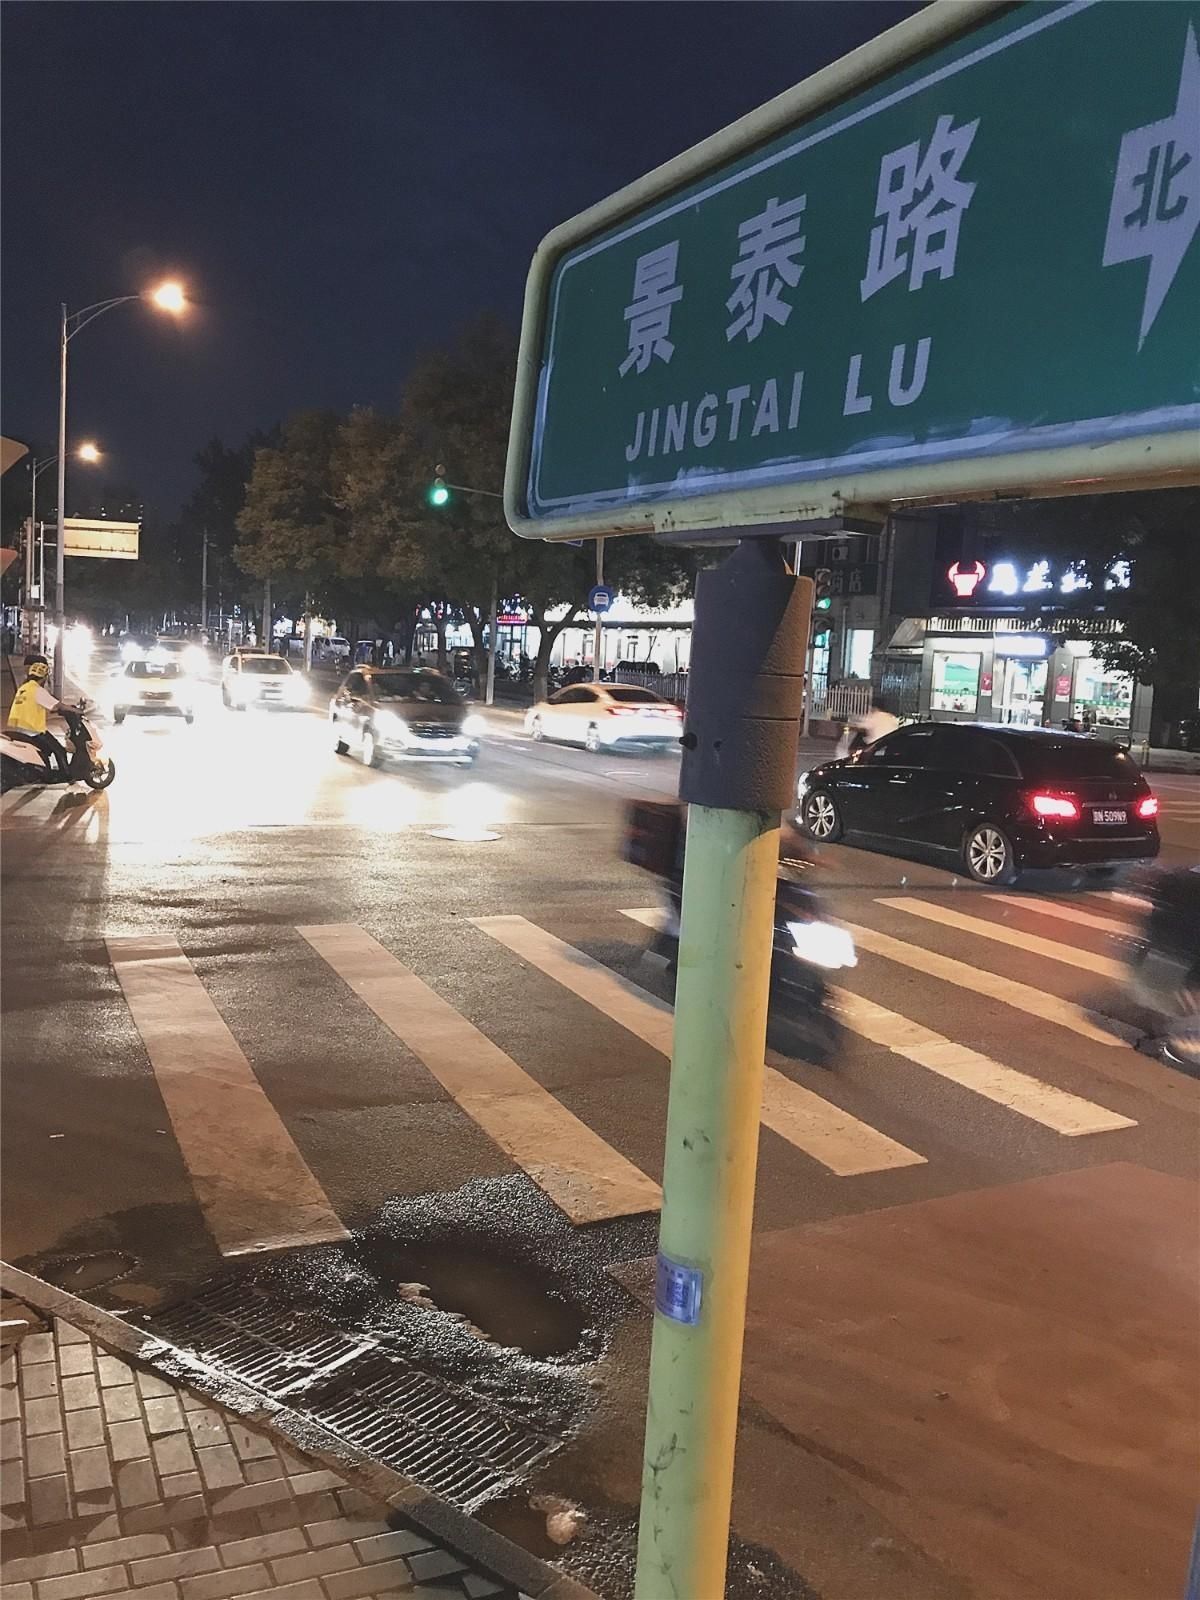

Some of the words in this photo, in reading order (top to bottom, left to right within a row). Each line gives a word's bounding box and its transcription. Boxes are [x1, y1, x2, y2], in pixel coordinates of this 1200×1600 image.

[1124, 140, 1192, 228] 北
[619, 115, 980, 377] 景泰路
[625, 371, 803, 461] JINGTAI
[843, 338, 931, 416] LU
